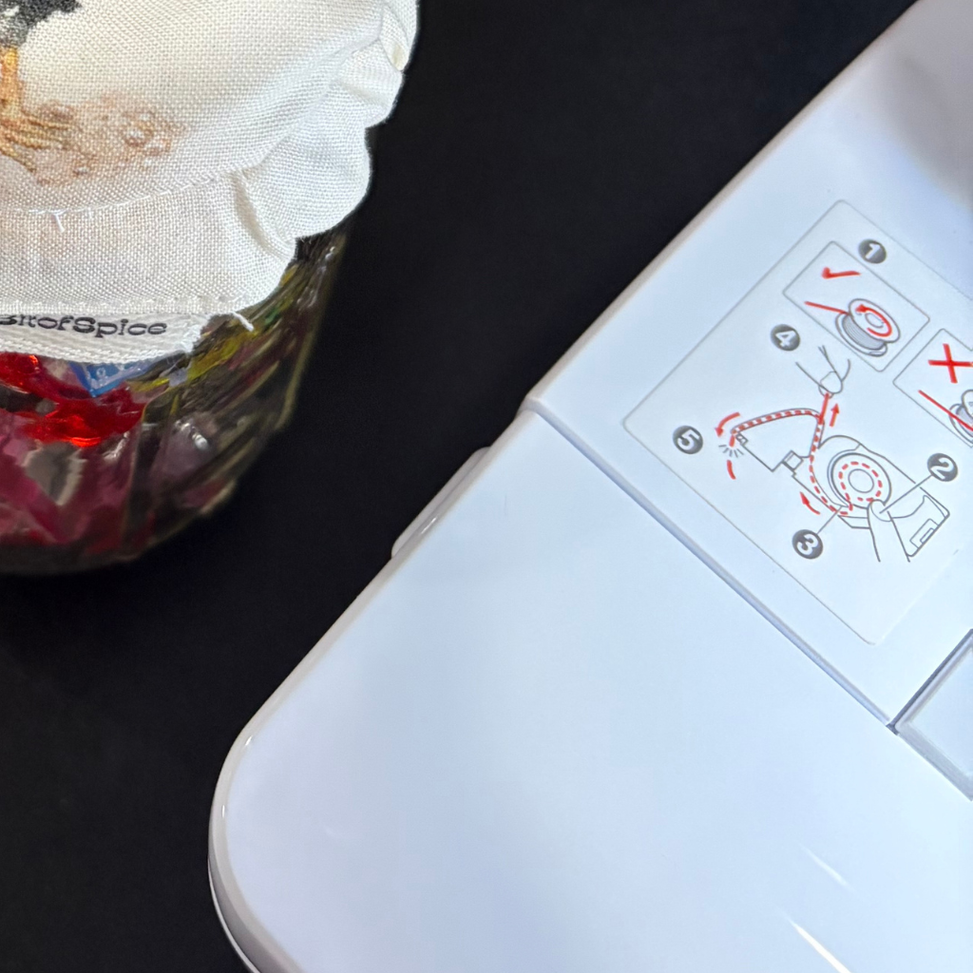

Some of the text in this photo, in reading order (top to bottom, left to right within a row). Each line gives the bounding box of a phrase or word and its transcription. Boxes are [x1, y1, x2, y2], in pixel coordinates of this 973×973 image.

[863, 241, 883, 262] 1
[774, 329, 796, 349] 4
[676, 428, 701, 452] 5
[930, 456, 954, 480] 2
[796, 533, 820, 556] 3
